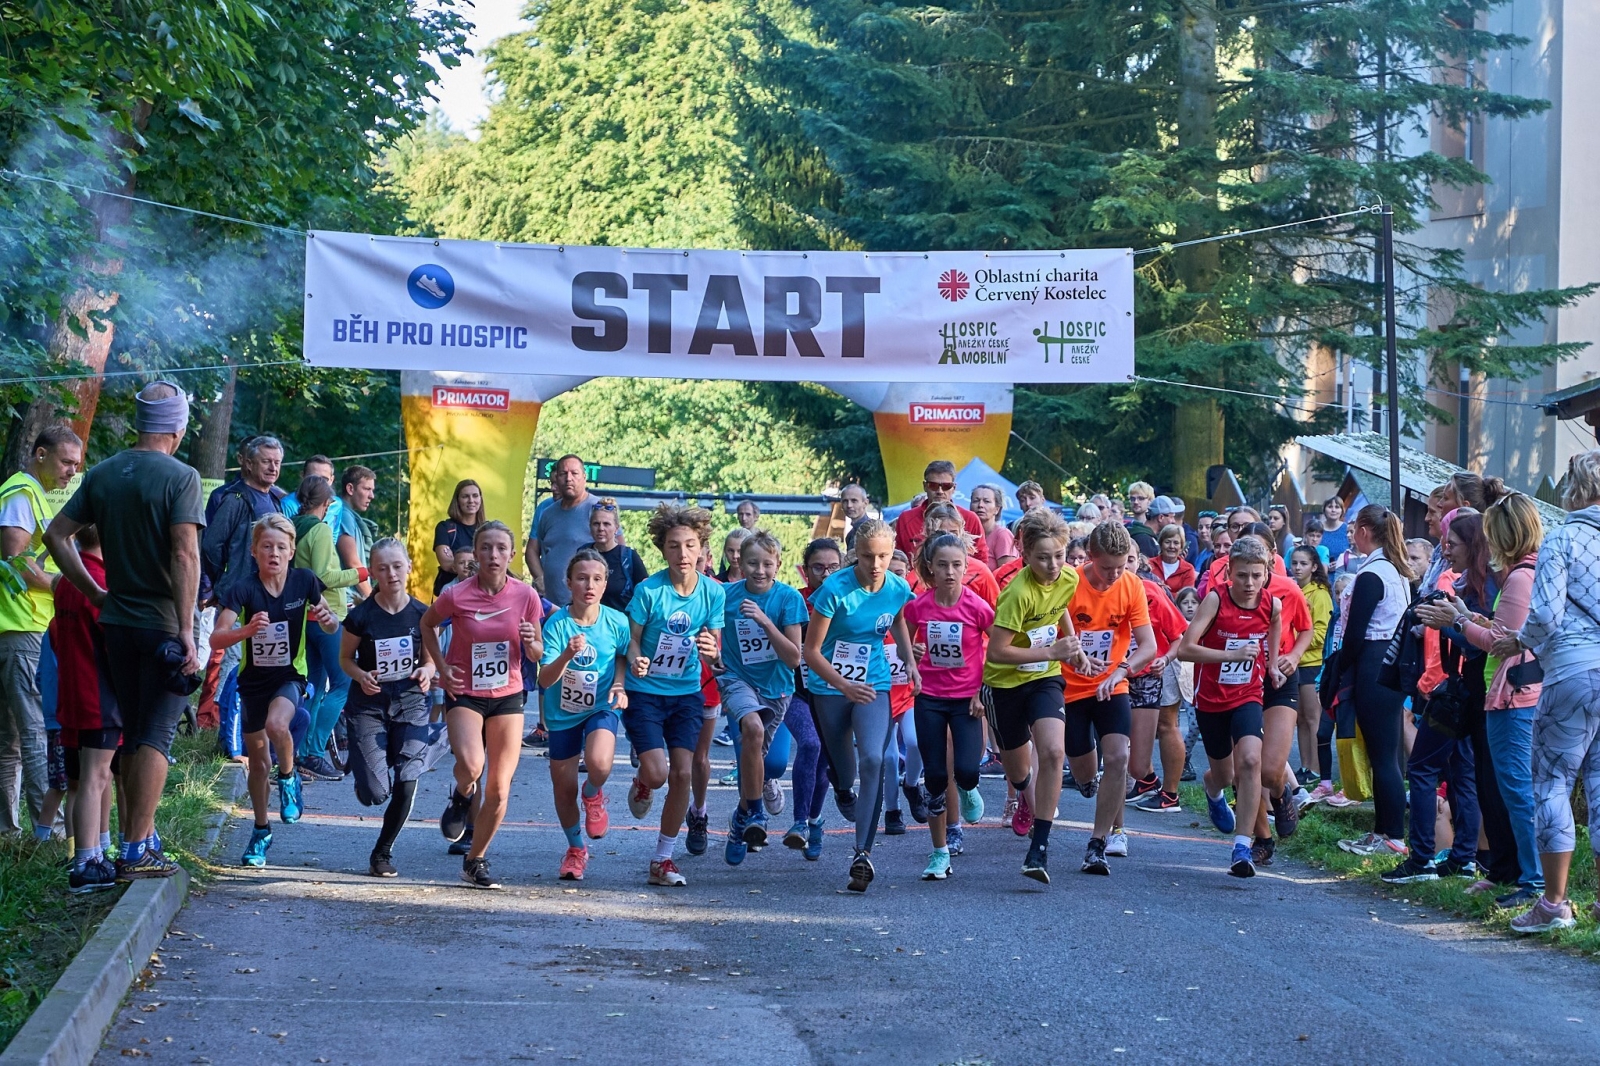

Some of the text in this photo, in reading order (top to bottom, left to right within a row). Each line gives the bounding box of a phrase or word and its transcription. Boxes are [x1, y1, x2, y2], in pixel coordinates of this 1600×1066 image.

[975, 268, 1099, 284] Oblastní charita
[975, 285, 1107, 305] Červený Kostelec
[571, 271, 881, 358] START
[333, 314, 528, 349] BĚH PRO HOSPIC
[943, 321, 998, 349] HOSPIC
[958, 337, 1011, 348] ANEŽKY ČESKÉ
[1071, 344, 1100, 354] ANEŽKY
[961, 349, 1010, 365] MOBILNÍ
[1071, 354, 1091, 364] ČESKÉ
[253, 641, 289, 656] 373
[739, 637, 771, 653] 397
[929, 643, 962, 659] 453
[378, 657, 412, 675] 319
[652, 653, 686, 669] 411
[1221, 660, 1253, 673] 370
[472, 660, 508, 679] 450
[832, 662, 867, 683] 322
[561, 686, 595, 706] 320
